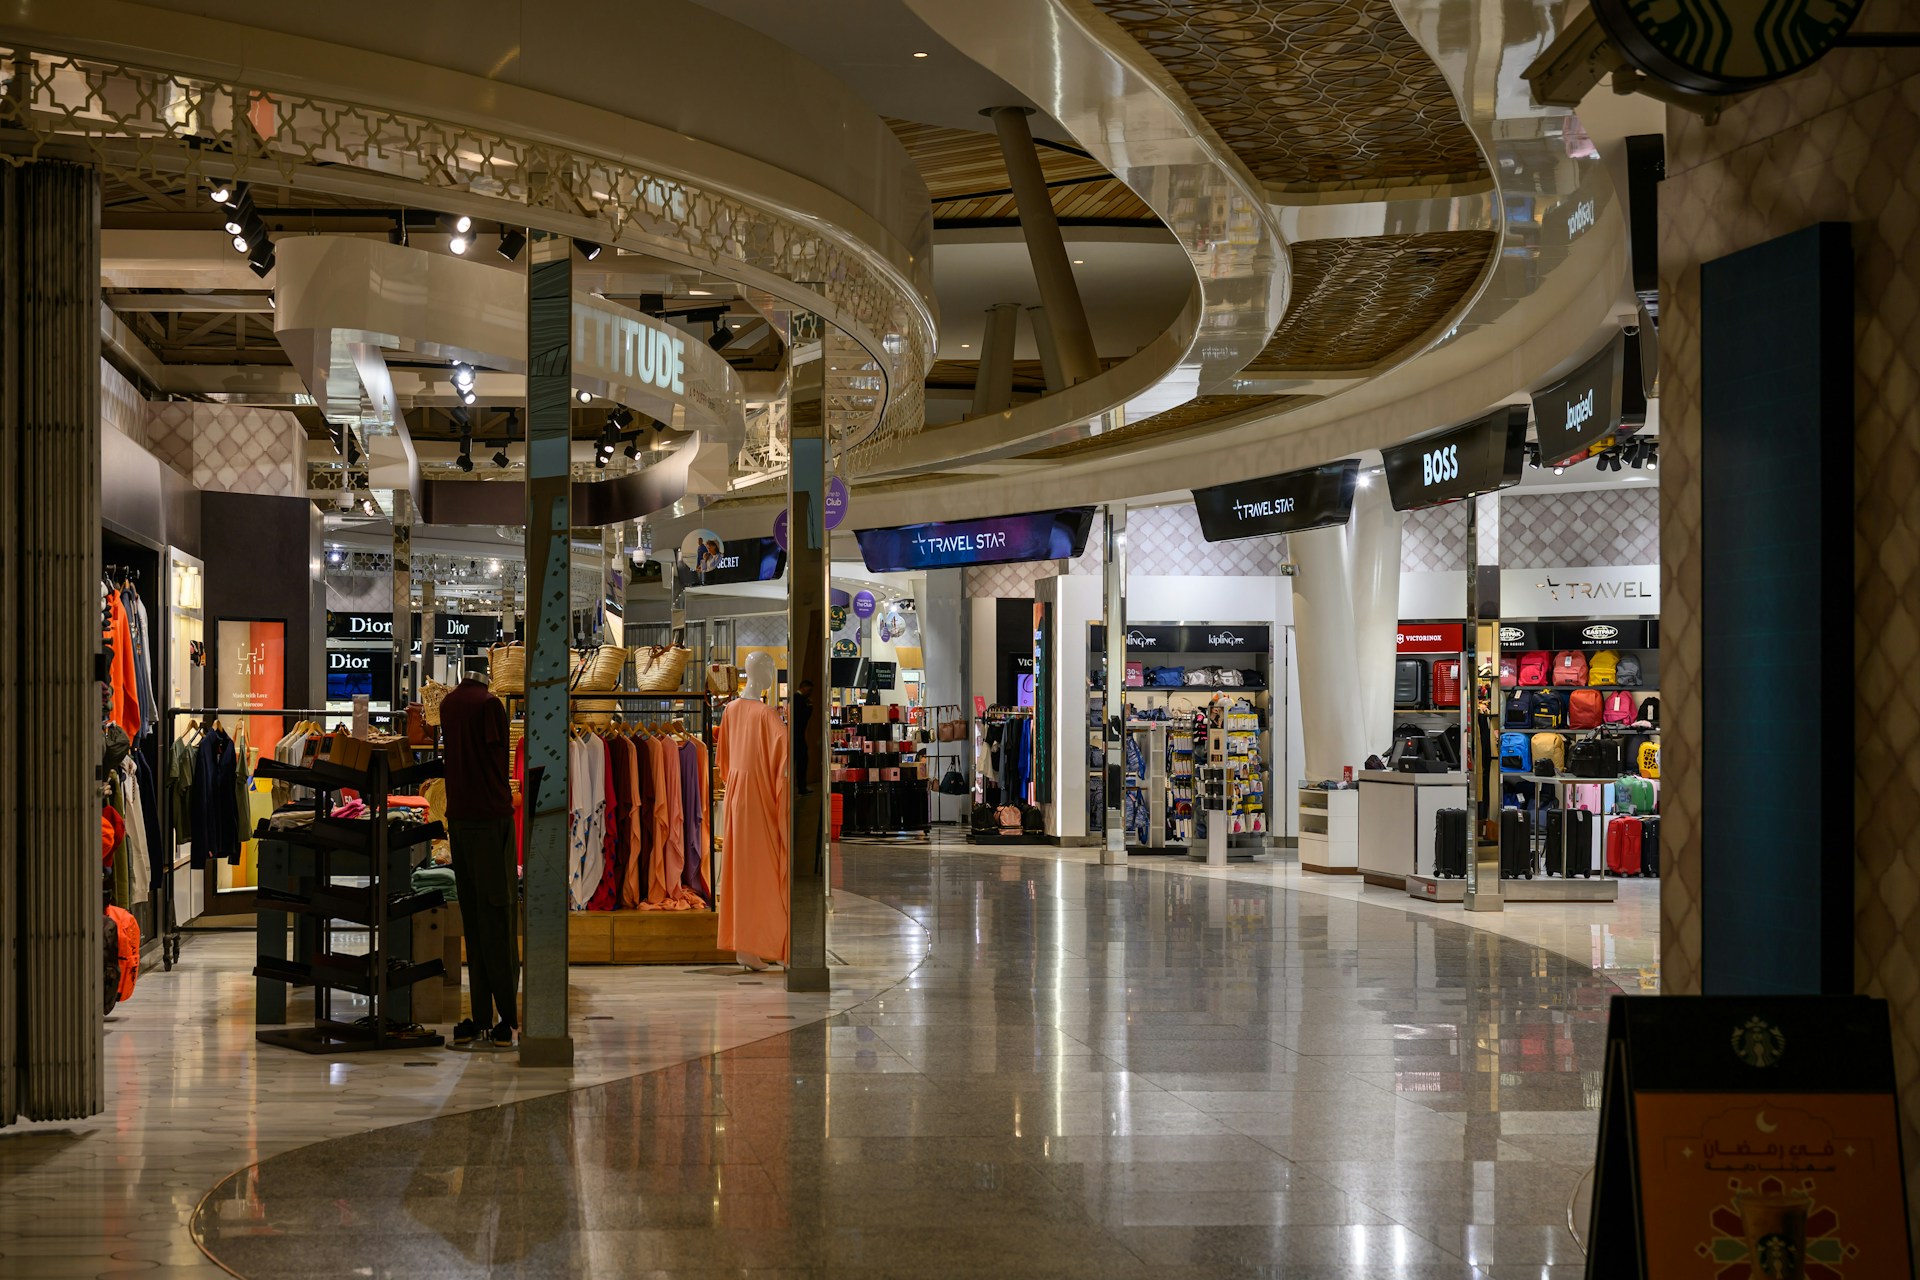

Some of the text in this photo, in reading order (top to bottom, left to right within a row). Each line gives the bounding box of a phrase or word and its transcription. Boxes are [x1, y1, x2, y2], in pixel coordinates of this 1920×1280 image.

[571, 302, 685, 396] TTITUDE
[1423, 444, 1459, 486] BOSS
[826, 498, 842, 506] Club
[1243, 497, 1295, 519] TRAVEL STAR
[927, 532, 1006, 552] TRAVEL STAR
[1565, 581, 1652, 599] TRAVEL
[349, 617, 393, 633] Dior
[446, 619, 470, 635] Dior
[237, 663, 265, 675] ZAIN
[329, 653, 371, 669] Dior
[1017, 658, 1033, 667] VIC
[1703, 1139, 1834, 1161] في رمضان
